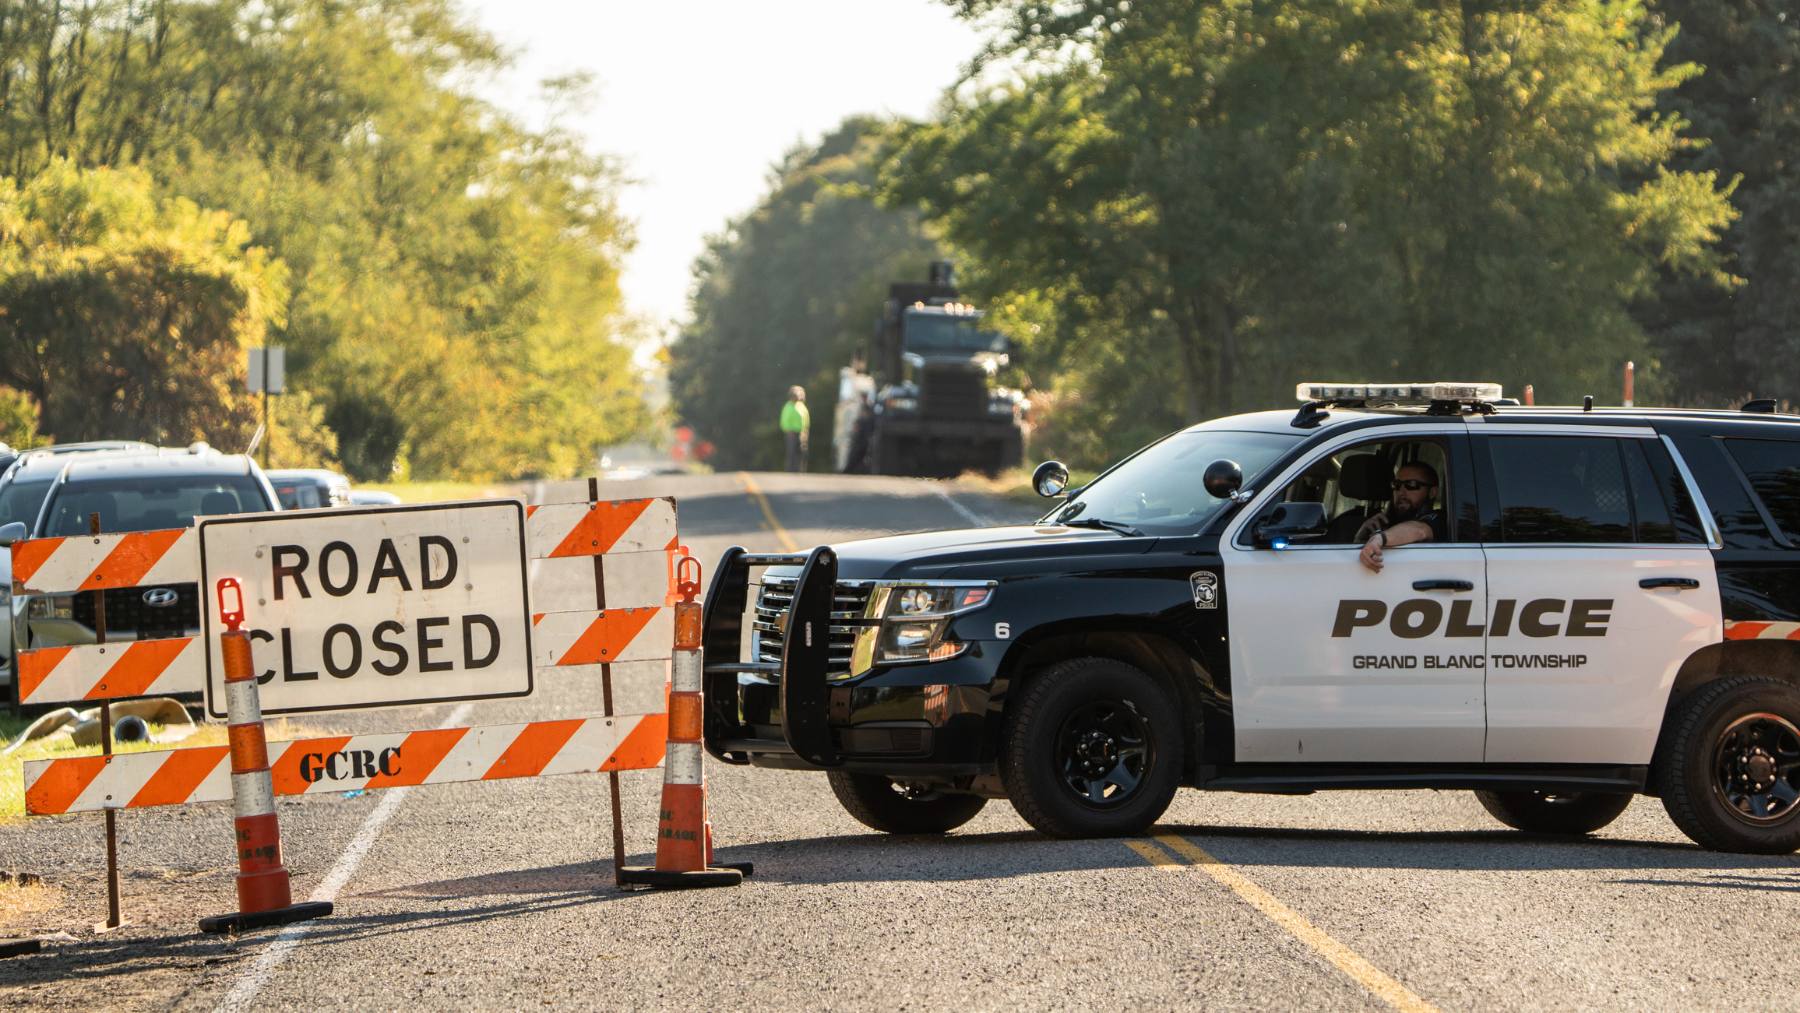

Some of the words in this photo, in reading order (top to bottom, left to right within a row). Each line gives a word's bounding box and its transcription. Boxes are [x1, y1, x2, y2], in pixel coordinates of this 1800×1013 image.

[271, 535, 458, 600] ROAD
[995, 622, 1010, 639] 6
[1331, 598, 1614, 639] POLICE
[249, 614, 501, 685] CLOSED
[1352, 655, 1417, 669] GRAND
[1423, 655, 1485, 669] BLANC
[1491, 654, 1587, 669] TOWNSHIP
[300, 747, 402, 783] GCRC
